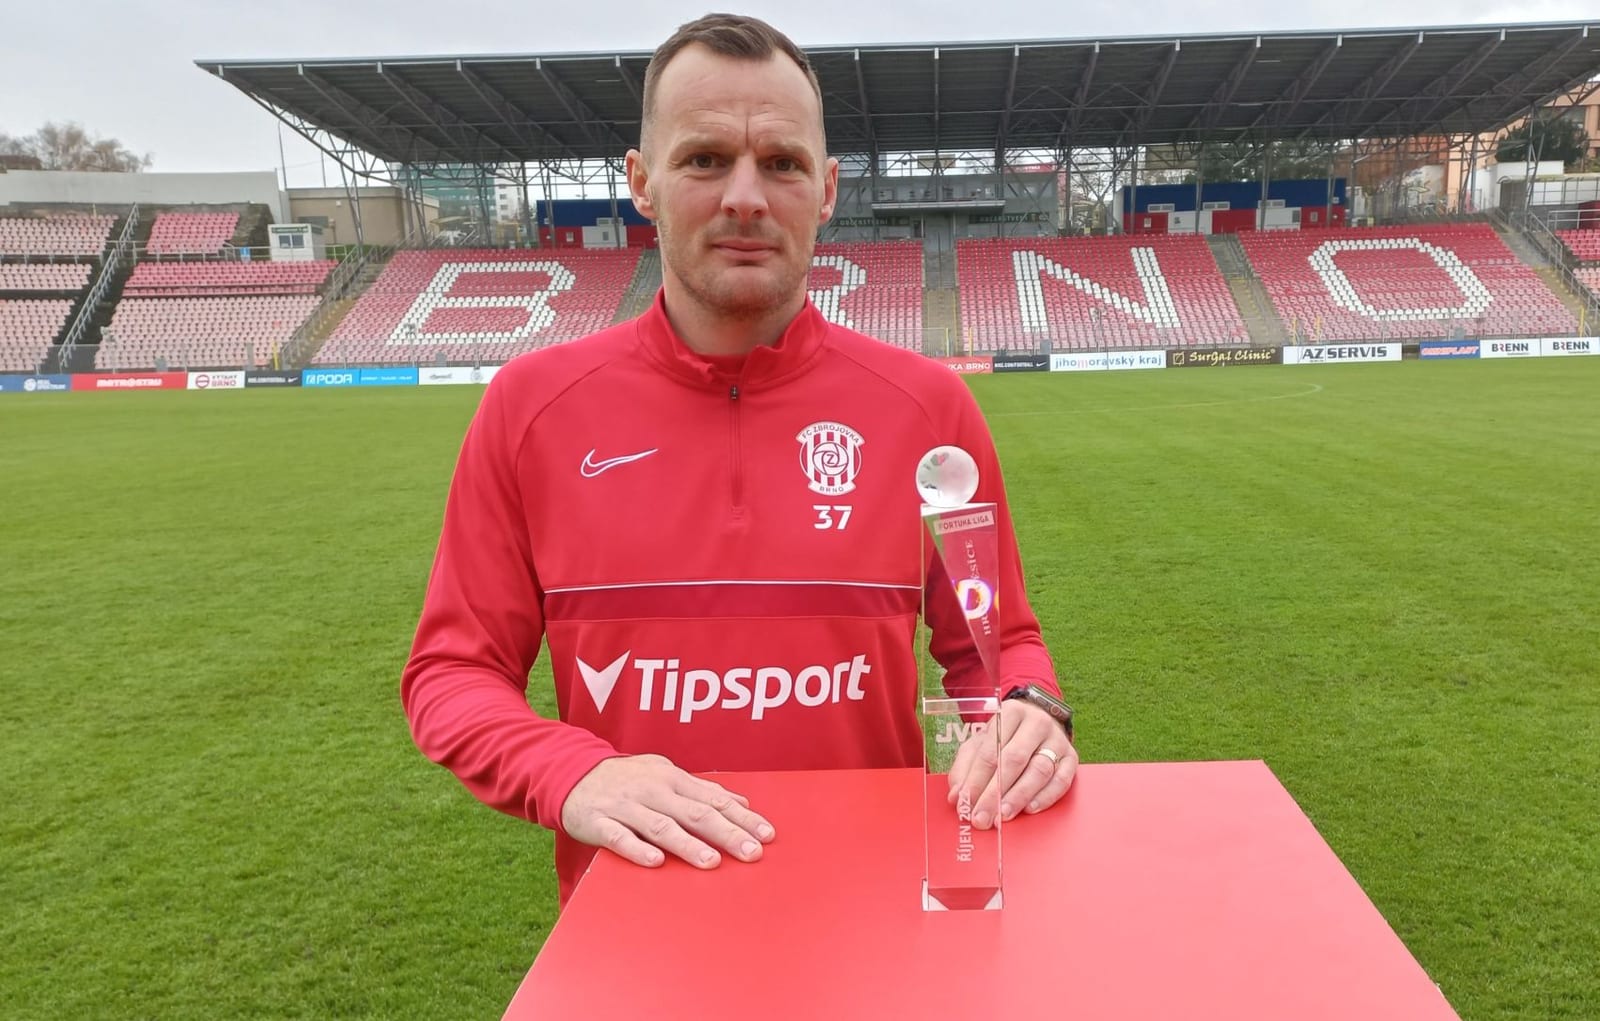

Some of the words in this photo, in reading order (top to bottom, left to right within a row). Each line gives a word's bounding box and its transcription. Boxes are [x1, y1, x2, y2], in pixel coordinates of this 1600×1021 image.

[1492, 343, 1529, 352] BRENN
[1553, 341, 1589, 350] BRENN
[1302, 348, 1325, 360] AZ
[1326, 346, 1388, 359] SERVIS
[965, 362, 991, 371] BRNO
[1055, 354, 1135, 369] jihomoravský
[1139, 353, 1163, 366] kraj
[316, 374, 353, 385] PODA
[802, 429, 813, 439] FC
[813, 423, 860, 444] ZBROJOVKA
[826, 453, 835, 465] Z
[819, 485, 844, 493] BRNO
[812, 504, 853, 530] 37
[633, 654, 871, 724] Tipsport
